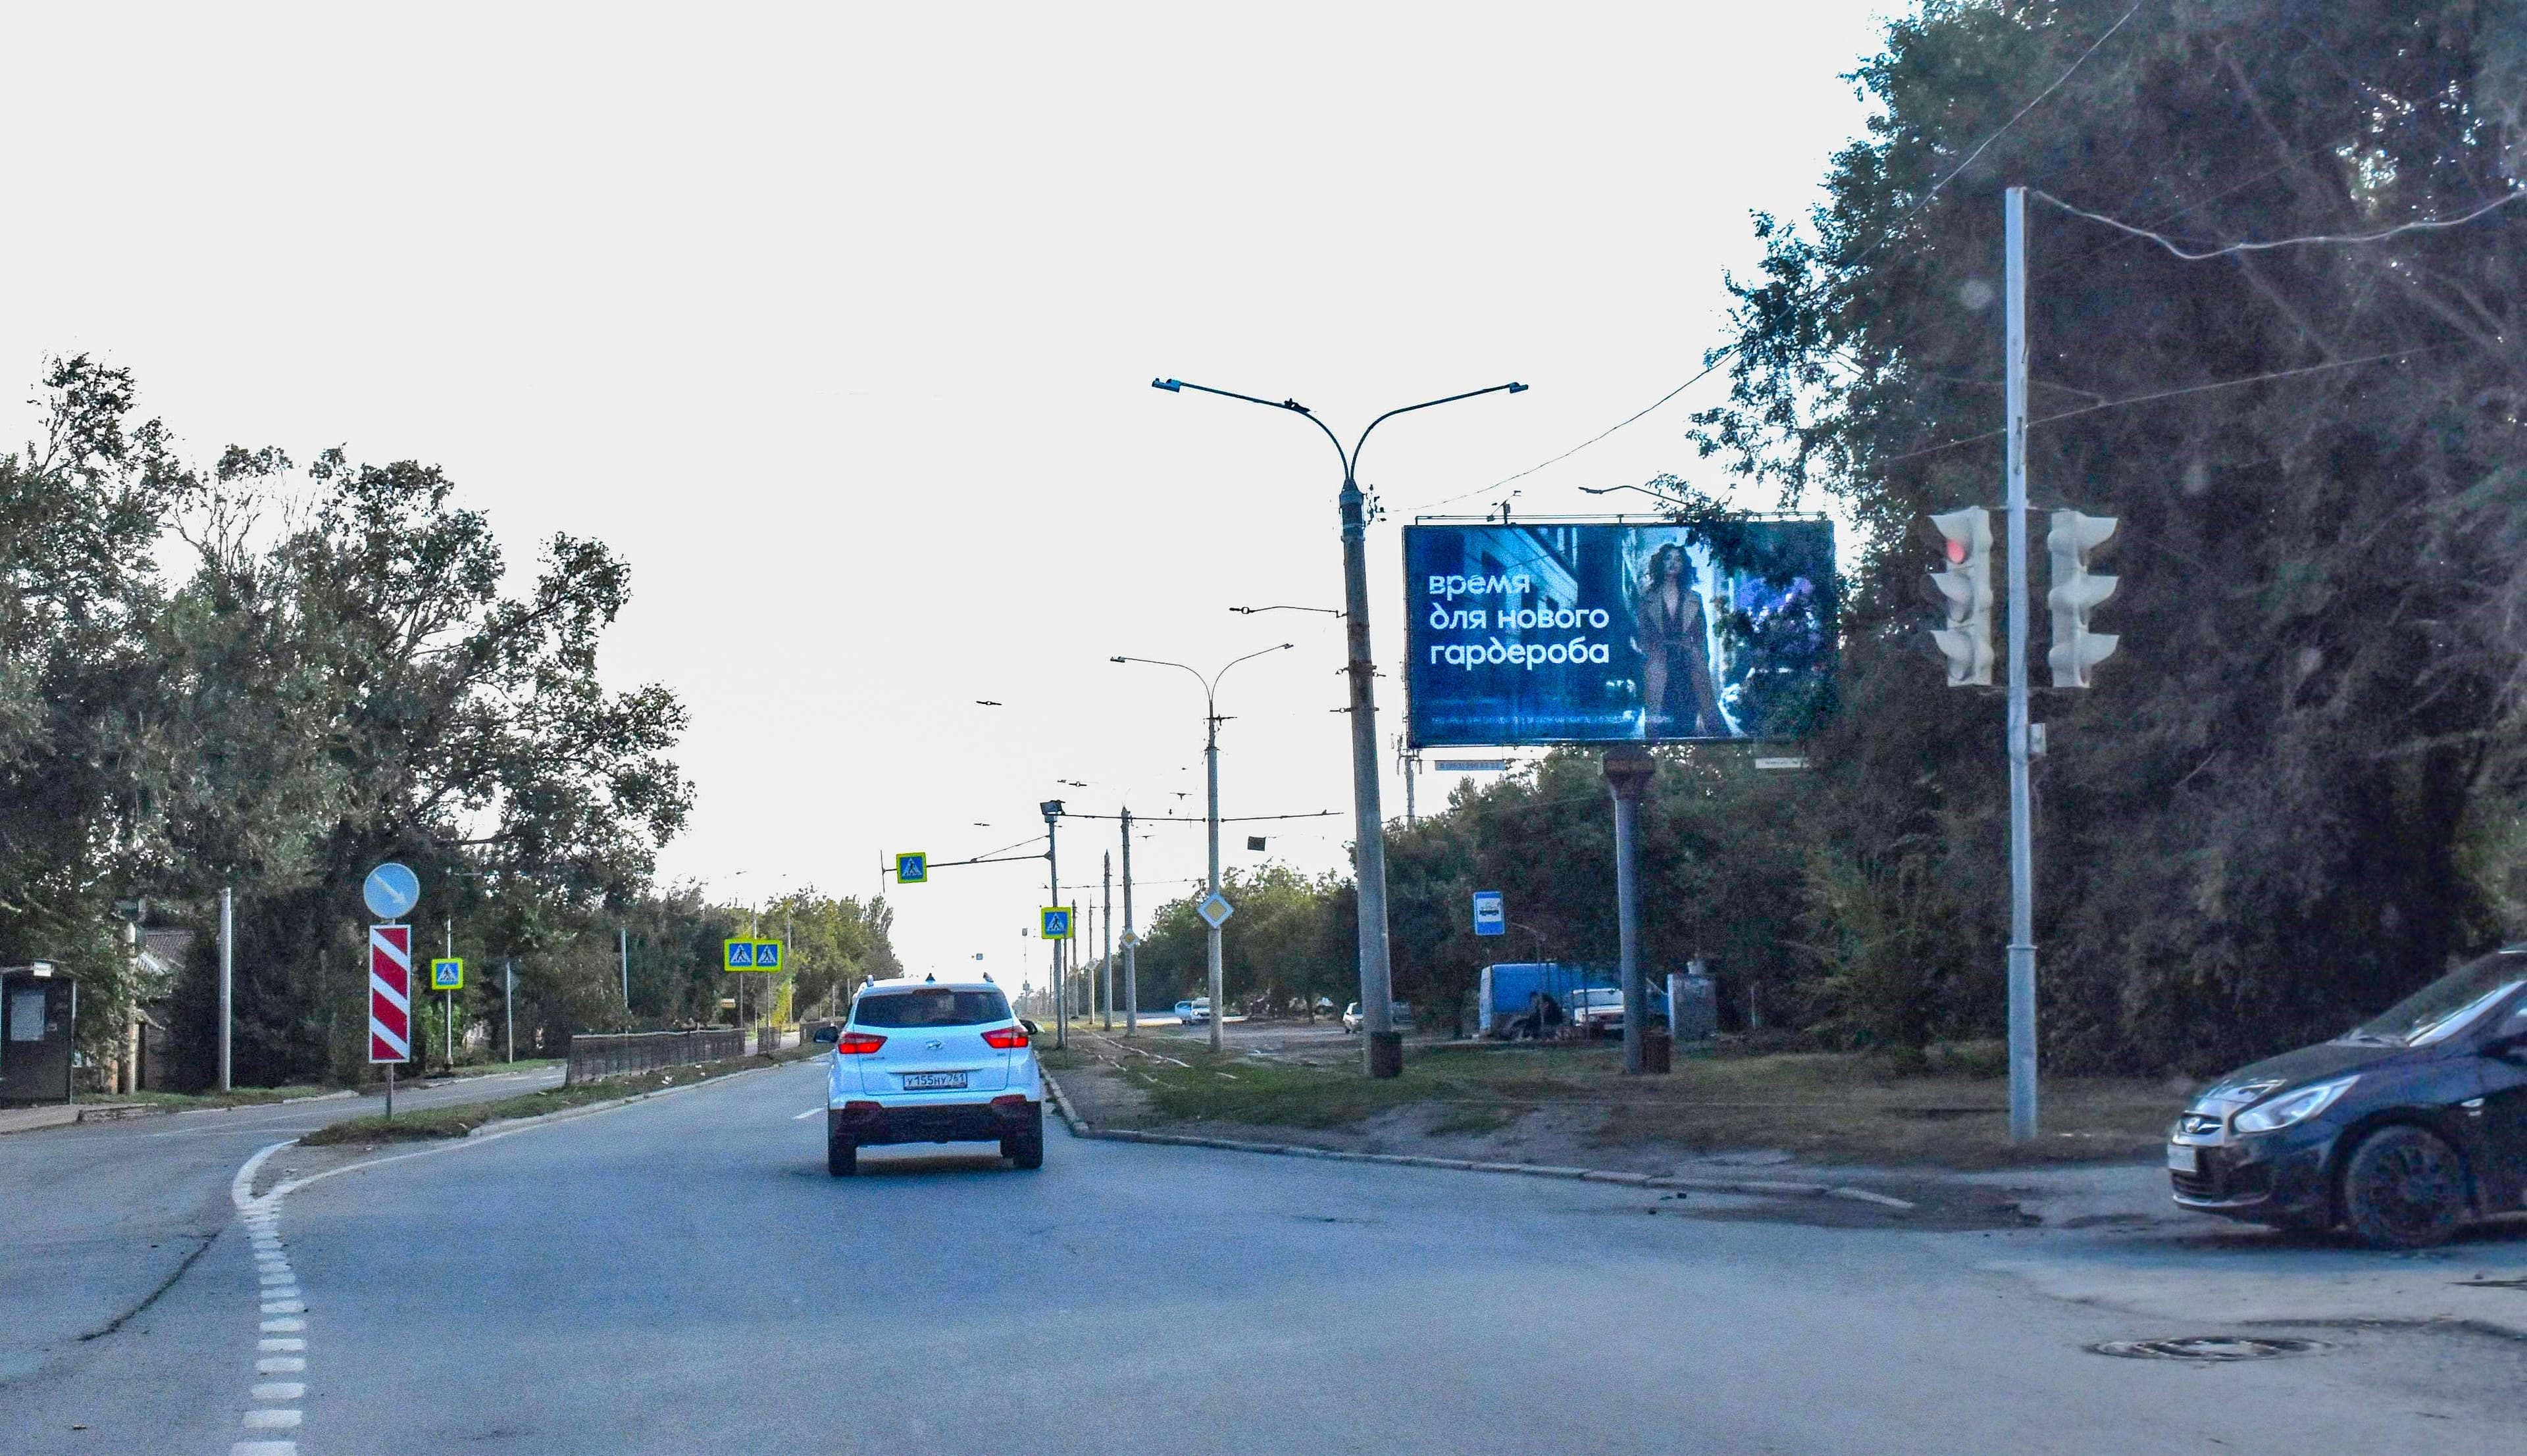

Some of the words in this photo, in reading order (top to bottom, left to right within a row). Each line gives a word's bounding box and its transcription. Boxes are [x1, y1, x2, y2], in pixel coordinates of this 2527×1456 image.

[1429, 574, 1530, 601] время
[1429, 602, 1487, 630] для
[1498, 609, 1610, 629] нового
[1431, 636, 1610, 671] гардероба
